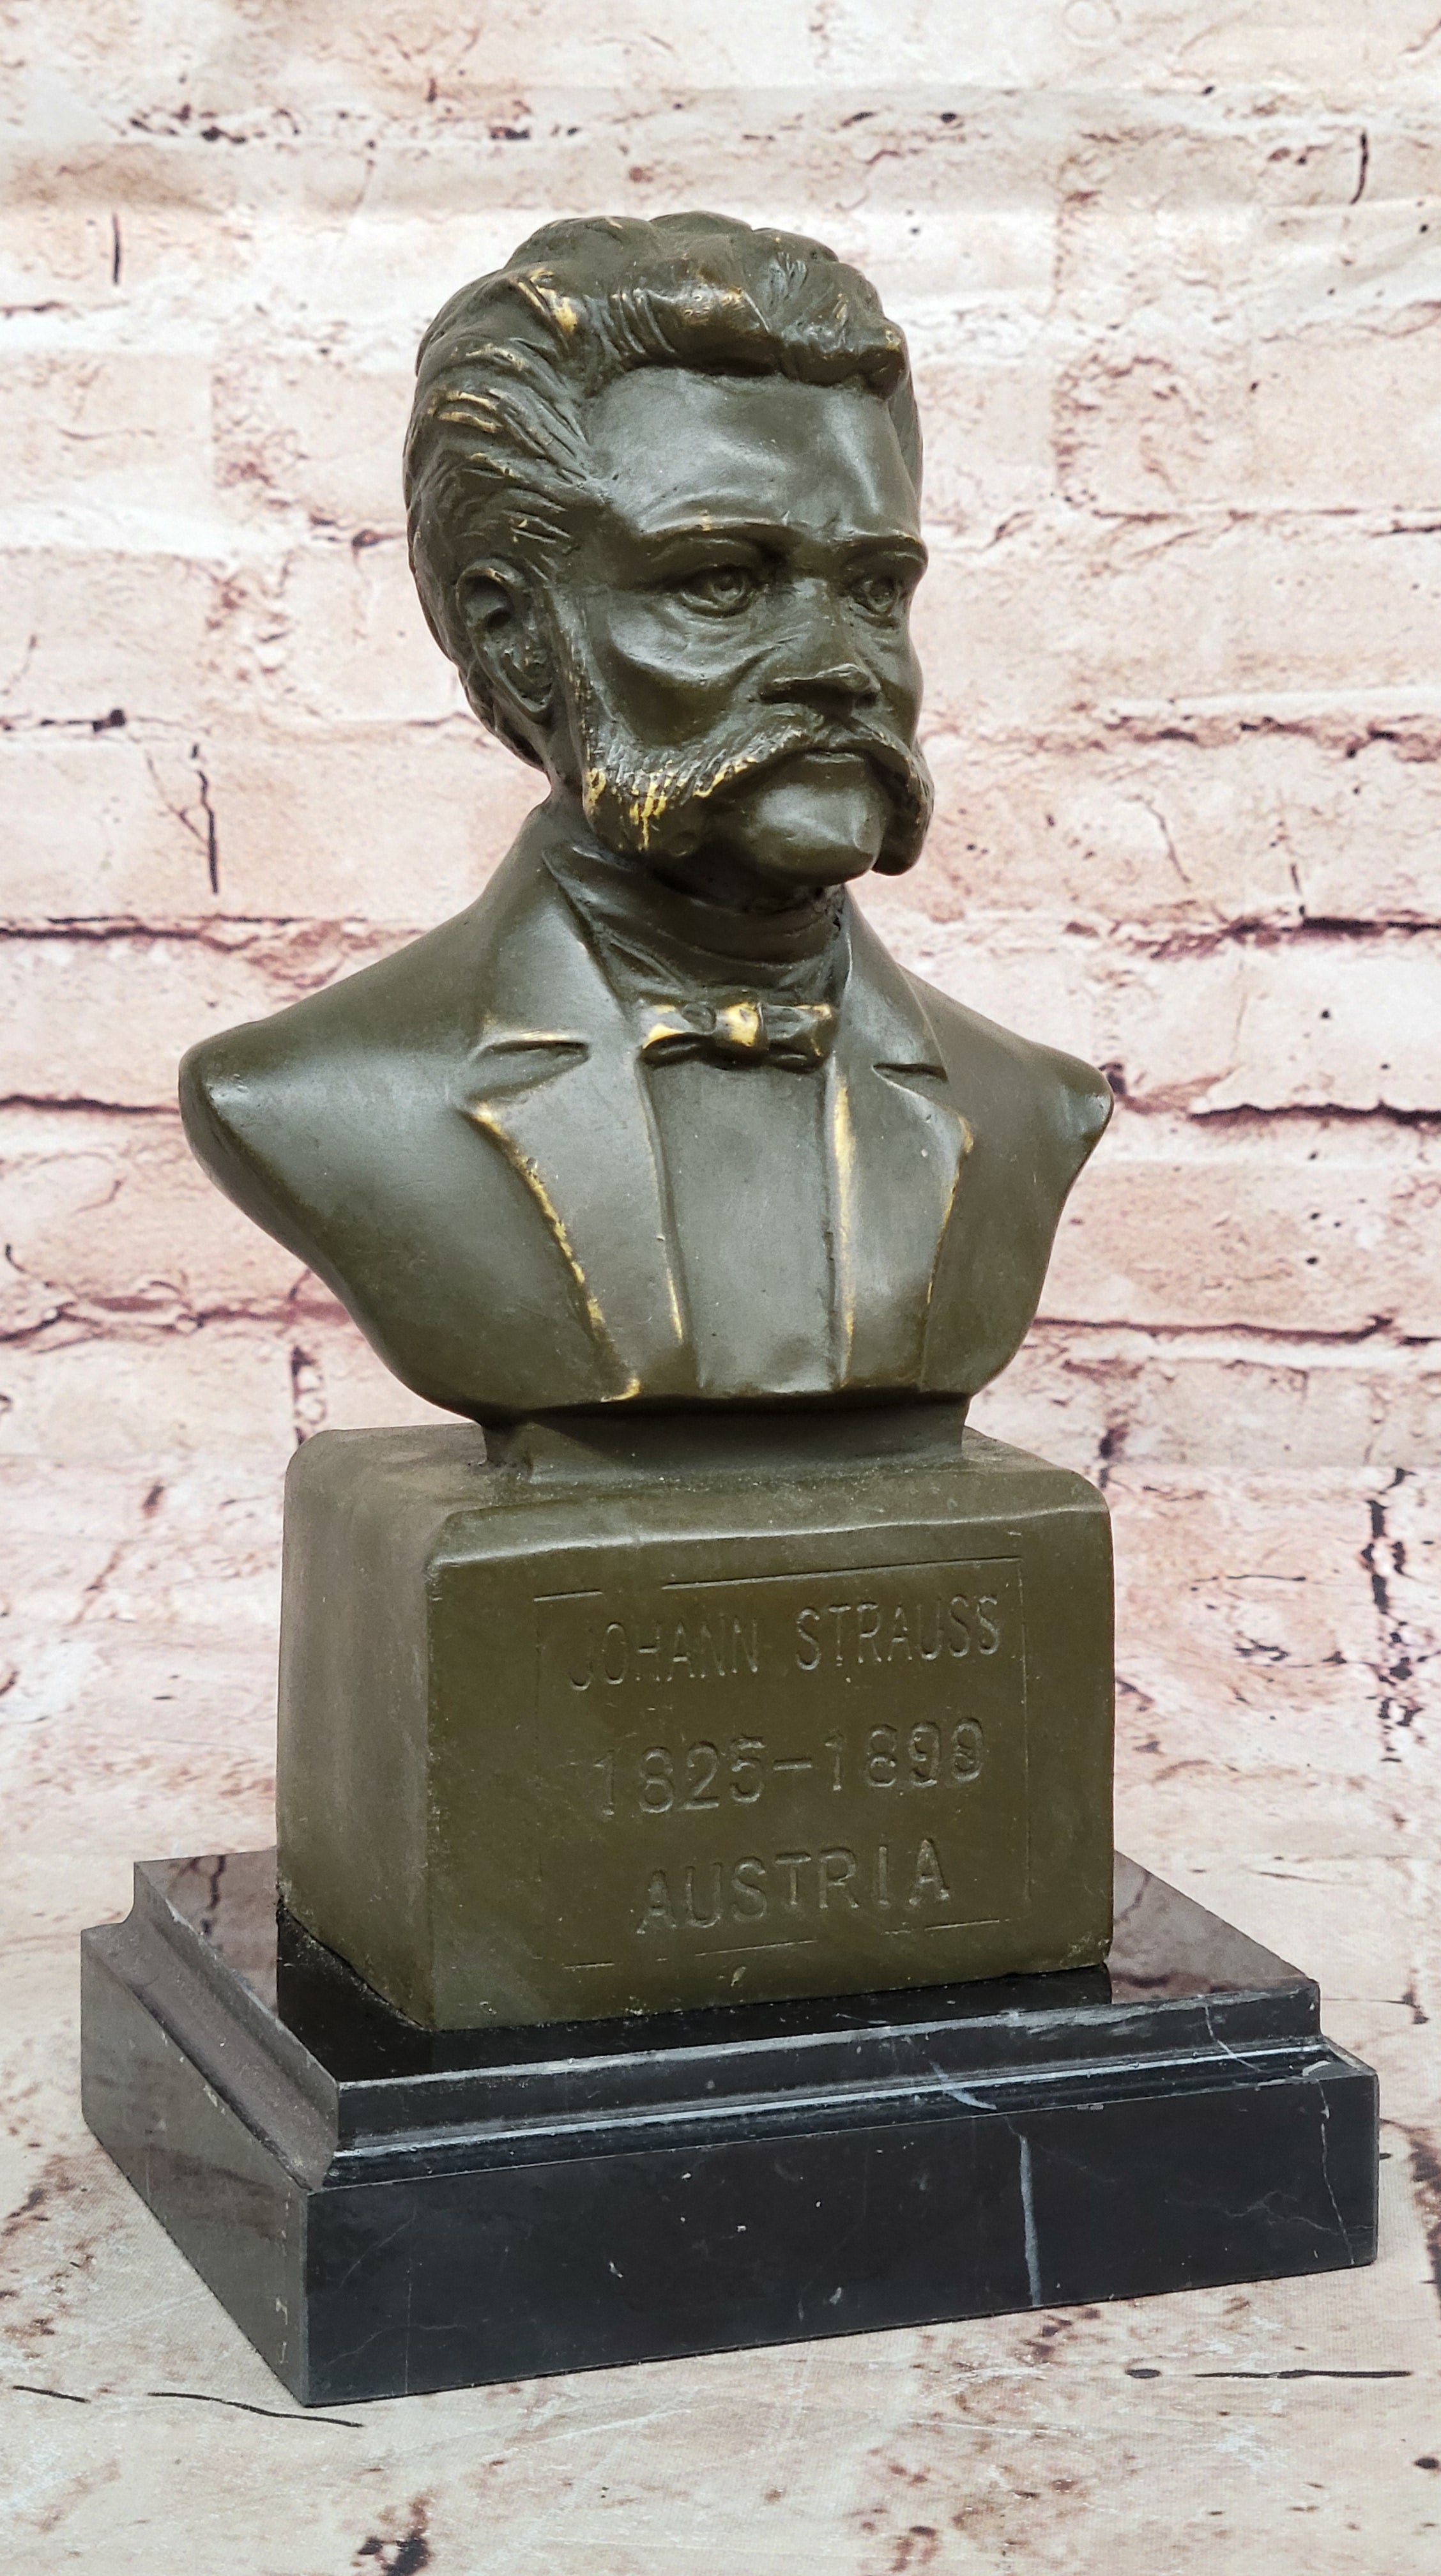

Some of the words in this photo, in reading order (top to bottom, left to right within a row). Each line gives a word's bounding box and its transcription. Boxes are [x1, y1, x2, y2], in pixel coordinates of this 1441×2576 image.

[567, 1611, 760, 1690] JOHANN
[795, 1595, 1002, 1671] STRAUSS
[593, 1717, 984, 1818] 1825-1899
[636, 1837, 950, 1935] AUSTRIA
